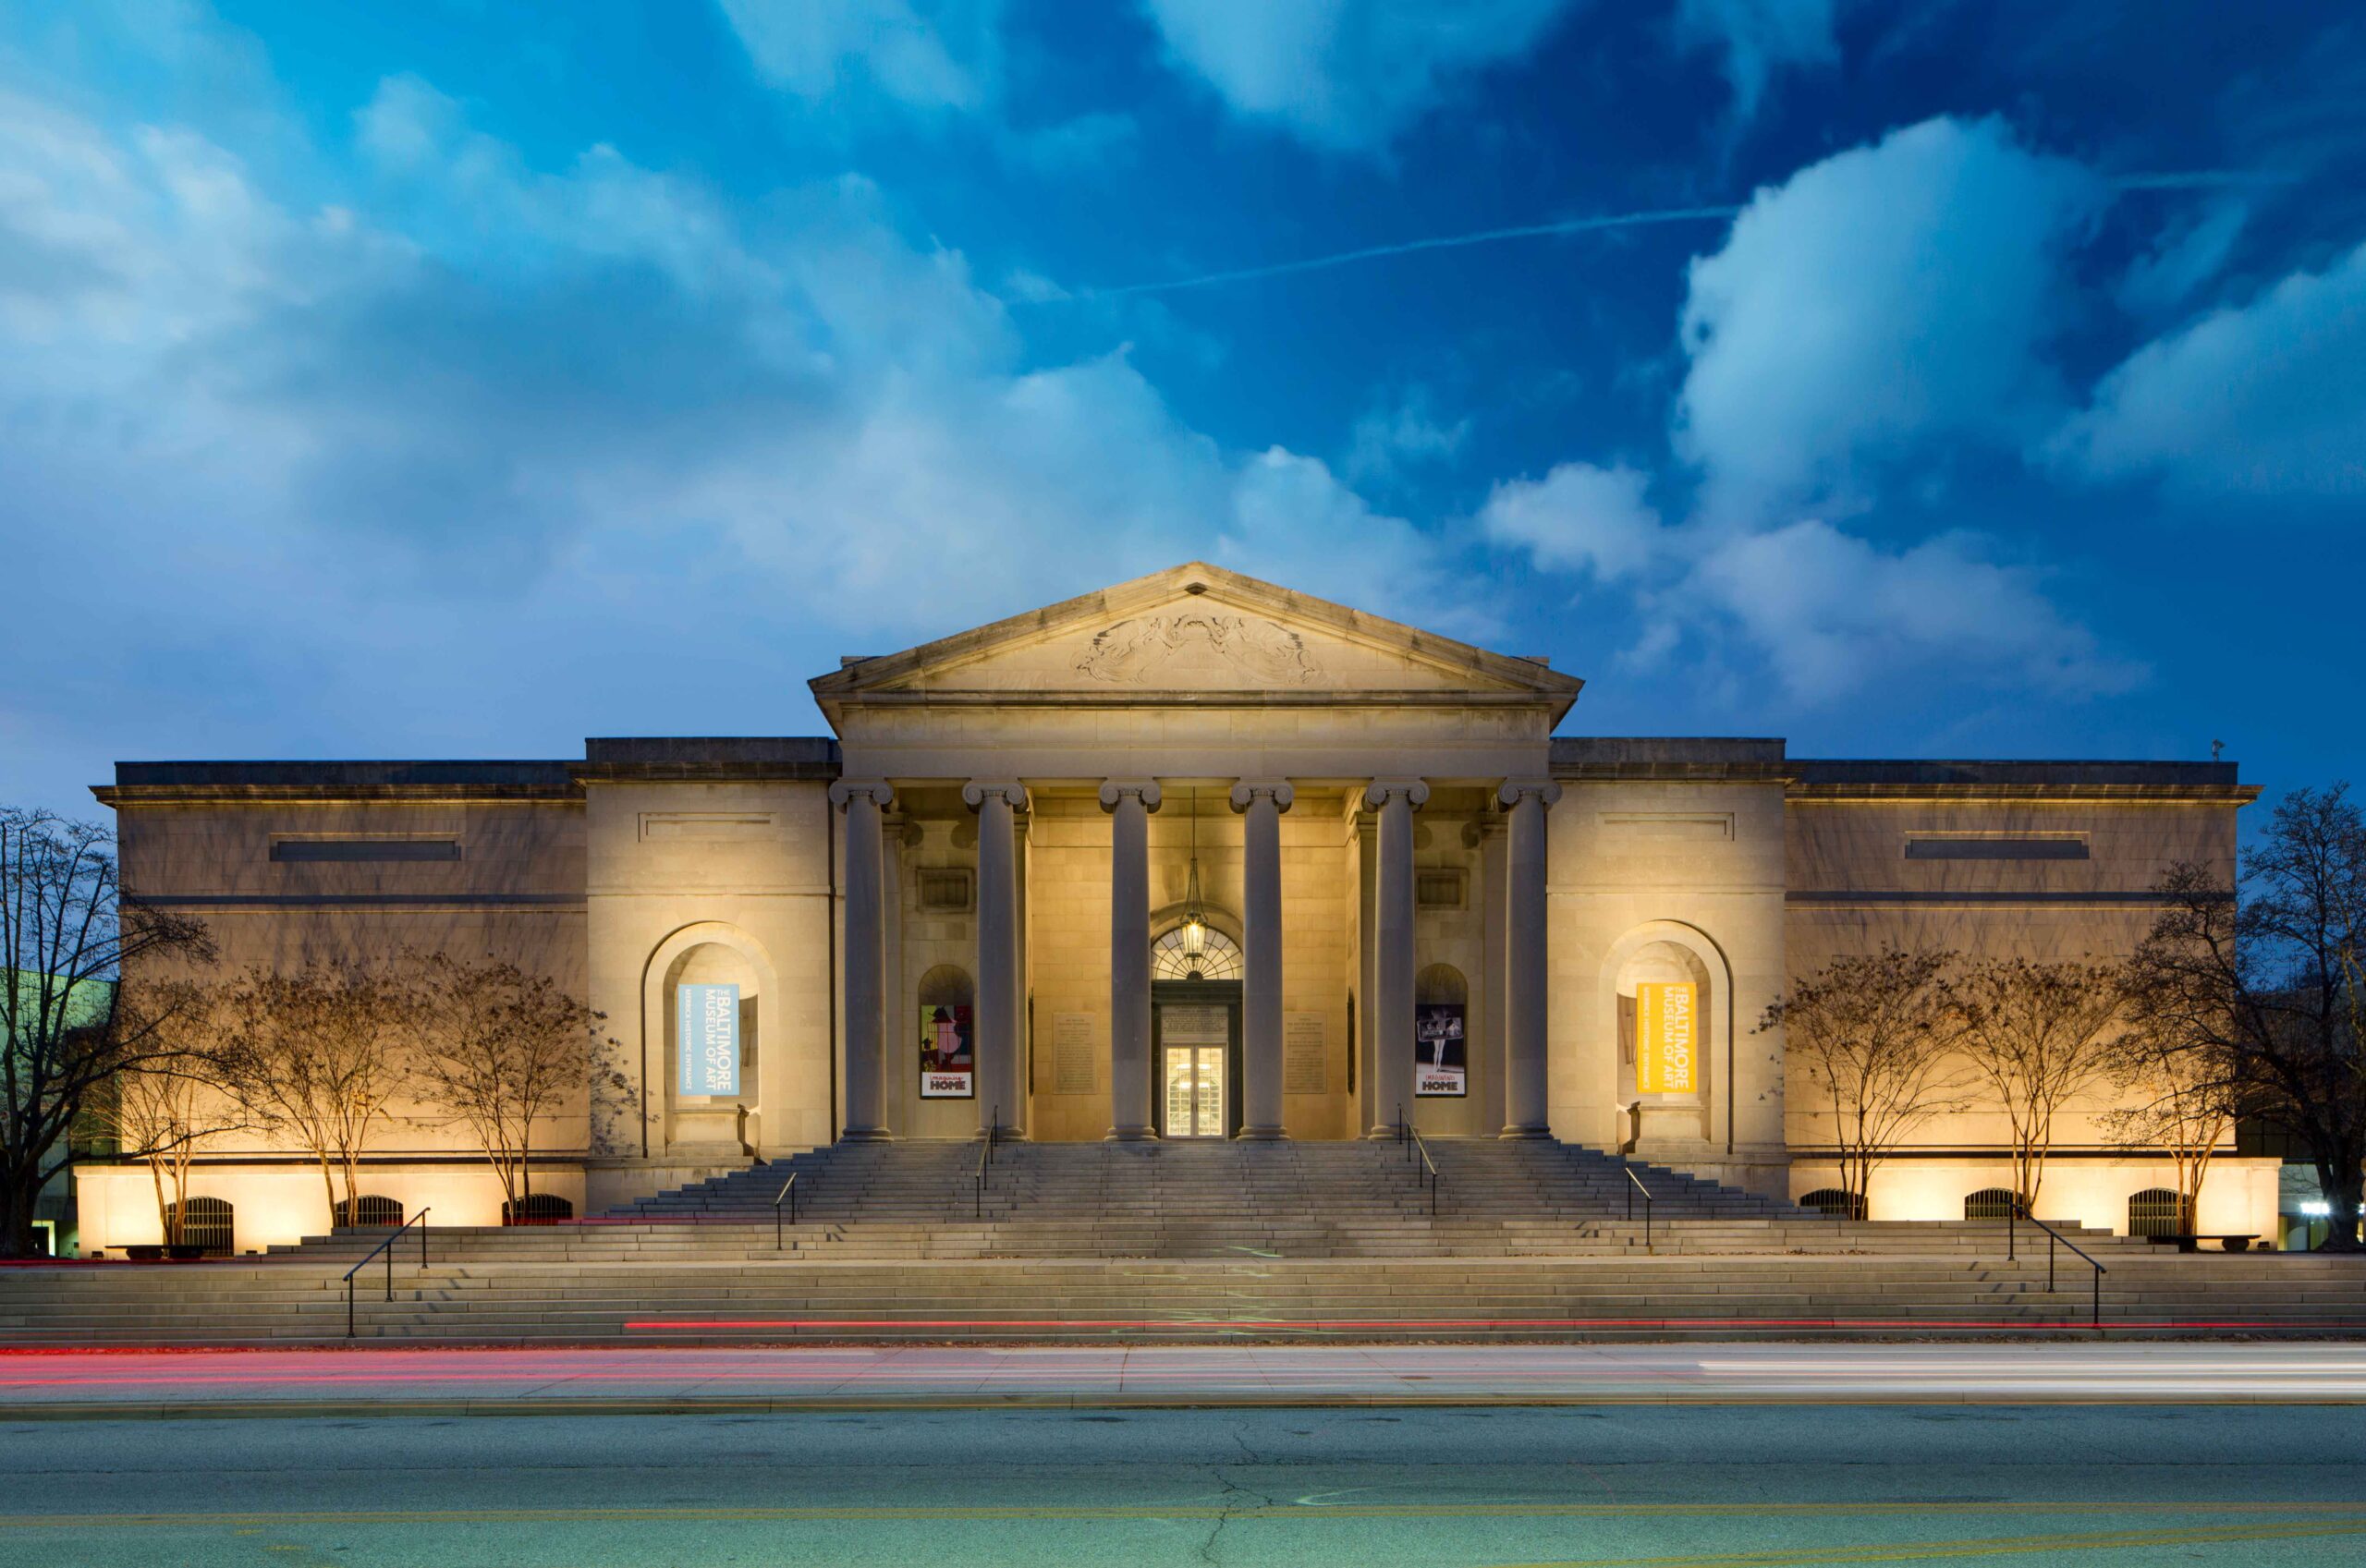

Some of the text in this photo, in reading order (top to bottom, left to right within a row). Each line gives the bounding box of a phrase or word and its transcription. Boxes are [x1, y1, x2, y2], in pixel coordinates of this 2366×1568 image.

[706, 989, 716, 1090] MUSEUM OF ART
[717, 996, 731, 1090] BALTIMORE
[1664, 986, 1674, 1088] MUSEUM OF ART
[1675, 993, 1689, 1089] BALTIMORE
[930, 1081, 966, 1090] HOME
[1422, 1081, 1458, 1090] HOME
